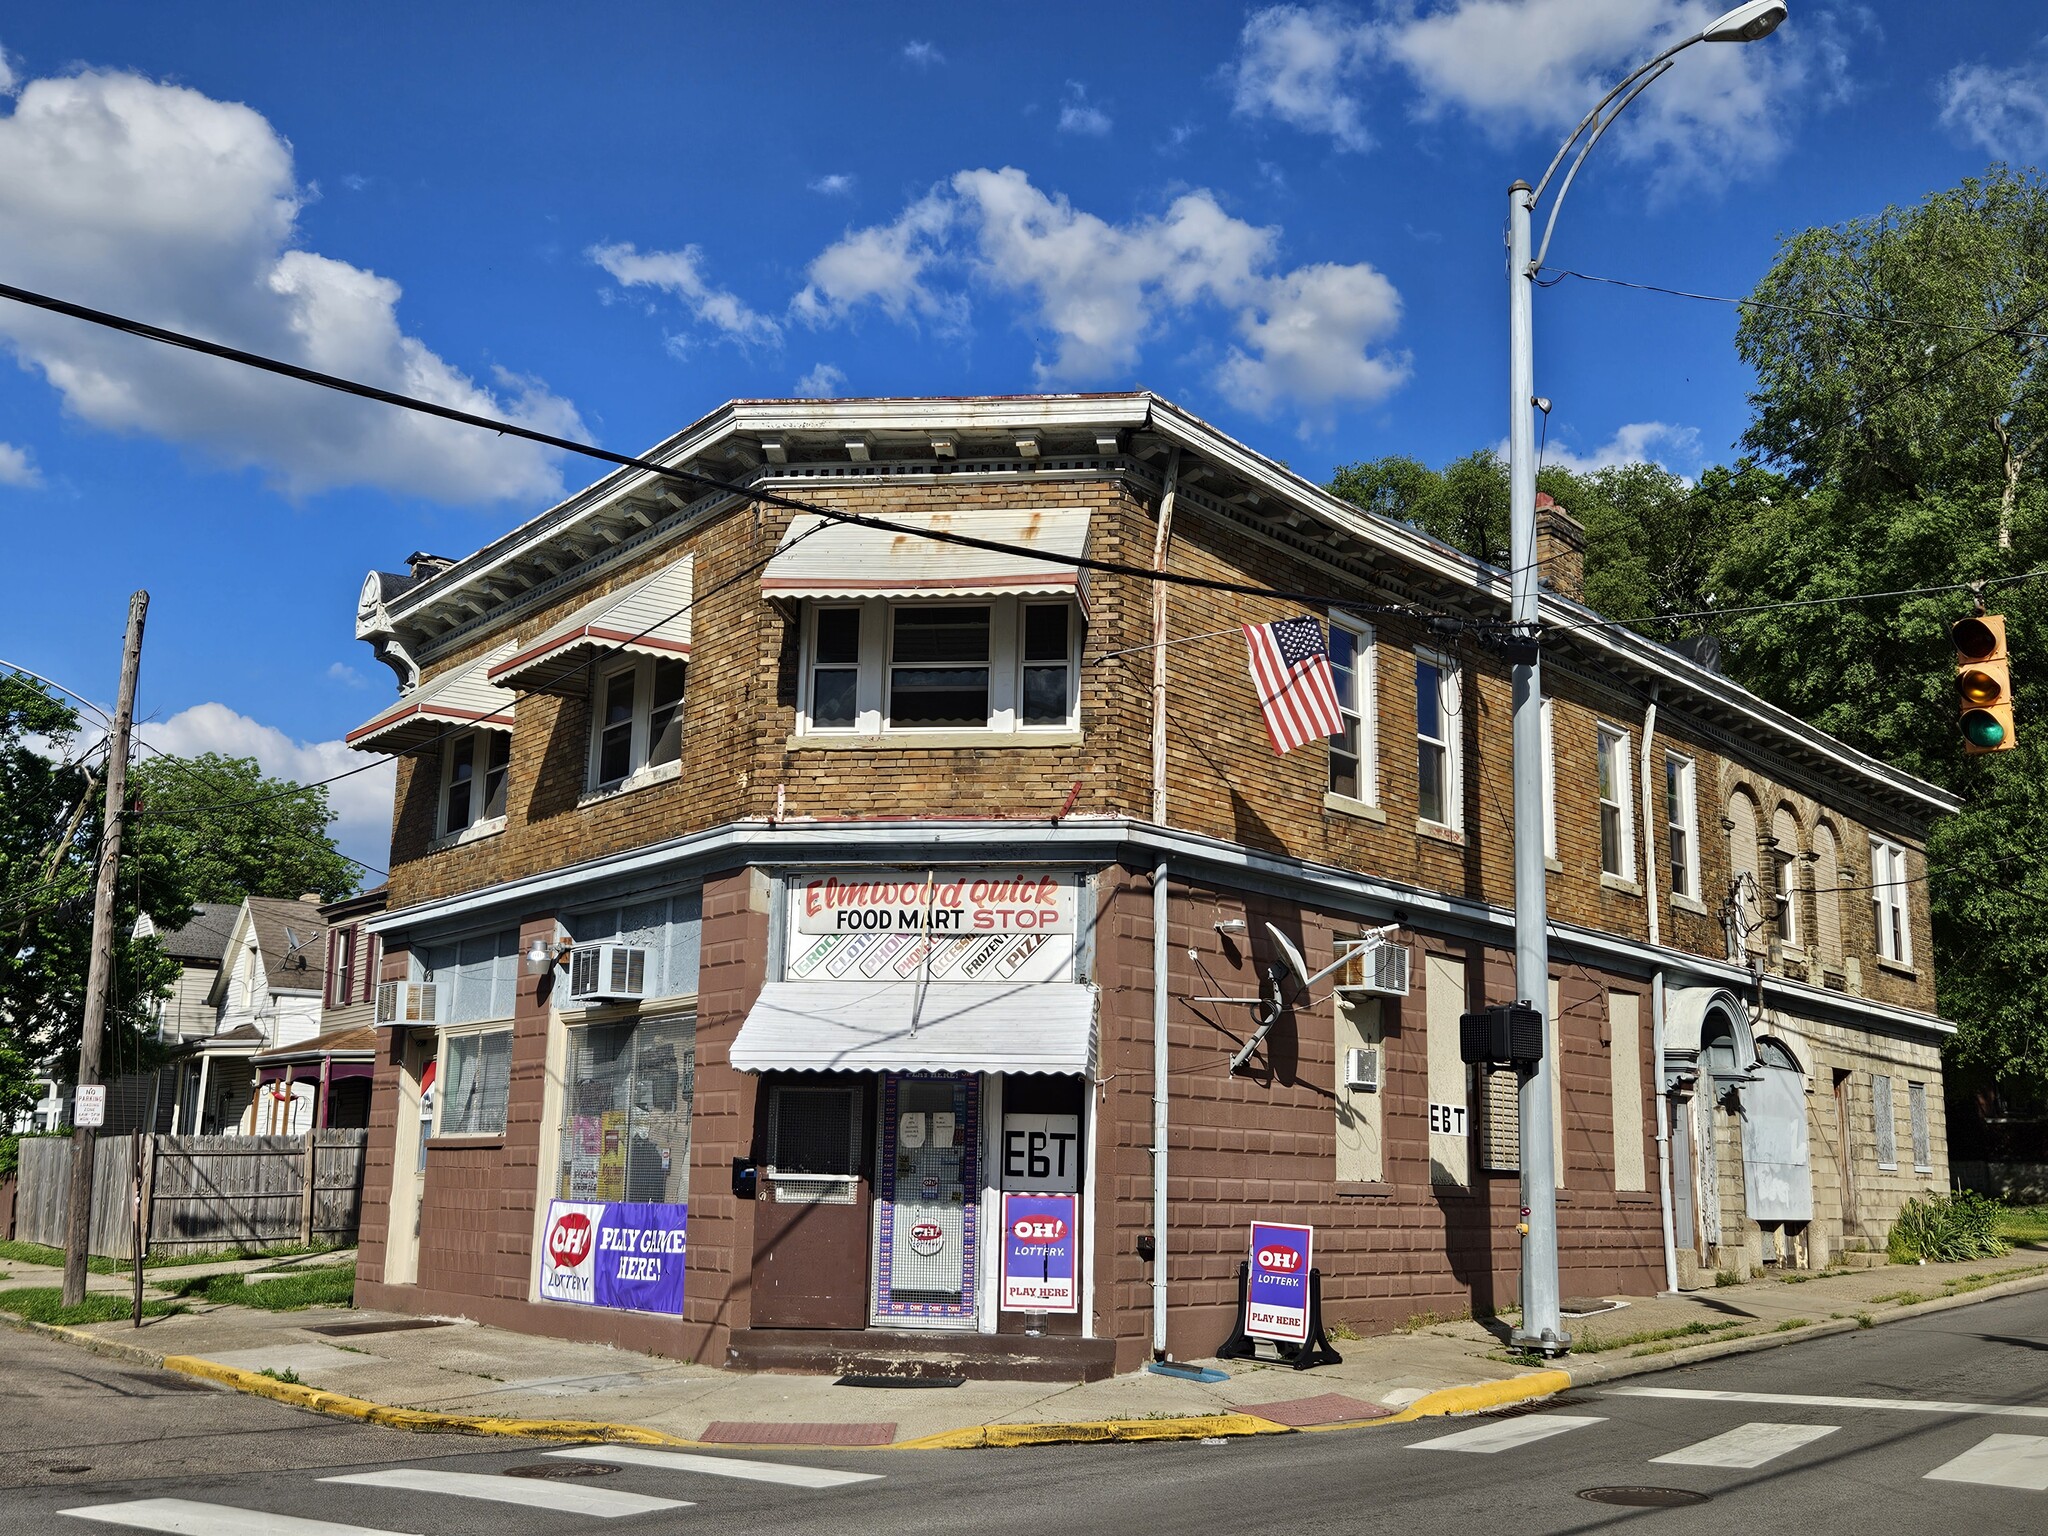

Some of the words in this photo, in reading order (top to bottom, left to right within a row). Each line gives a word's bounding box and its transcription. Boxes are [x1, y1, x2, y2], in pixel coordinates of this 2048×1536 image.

[806, 876, 966, 918] Elmwood
[837, 909, 892, 929] FOOD
[899, 909, 964, 929] MART
[973, 910, 1059, 930] STOP
[965, 935, 1004, 975] FROZEN
[85, 1088, 96, 1096] NO
[1430, 1104, 1465, 1133] EBT
[1004, 1131, 1076, 1177] EBT
[552, 1223, 591, 1255] OH!
[1014, 1220, 1062, 1239] OH!
[617, 1256, 661, 1282] HERE!
[1258, 1250, 1299, 1269] OH!
[548, 1272, 589, 1292] LOTTERY
[1009, 1287, 1037, 1298] PLAY
[1039, 1287, 1068, 1297] HERE
[1252, 1312, 1274, 1324] PLAY
[1276, 1315, 1301, 1327] HERE
